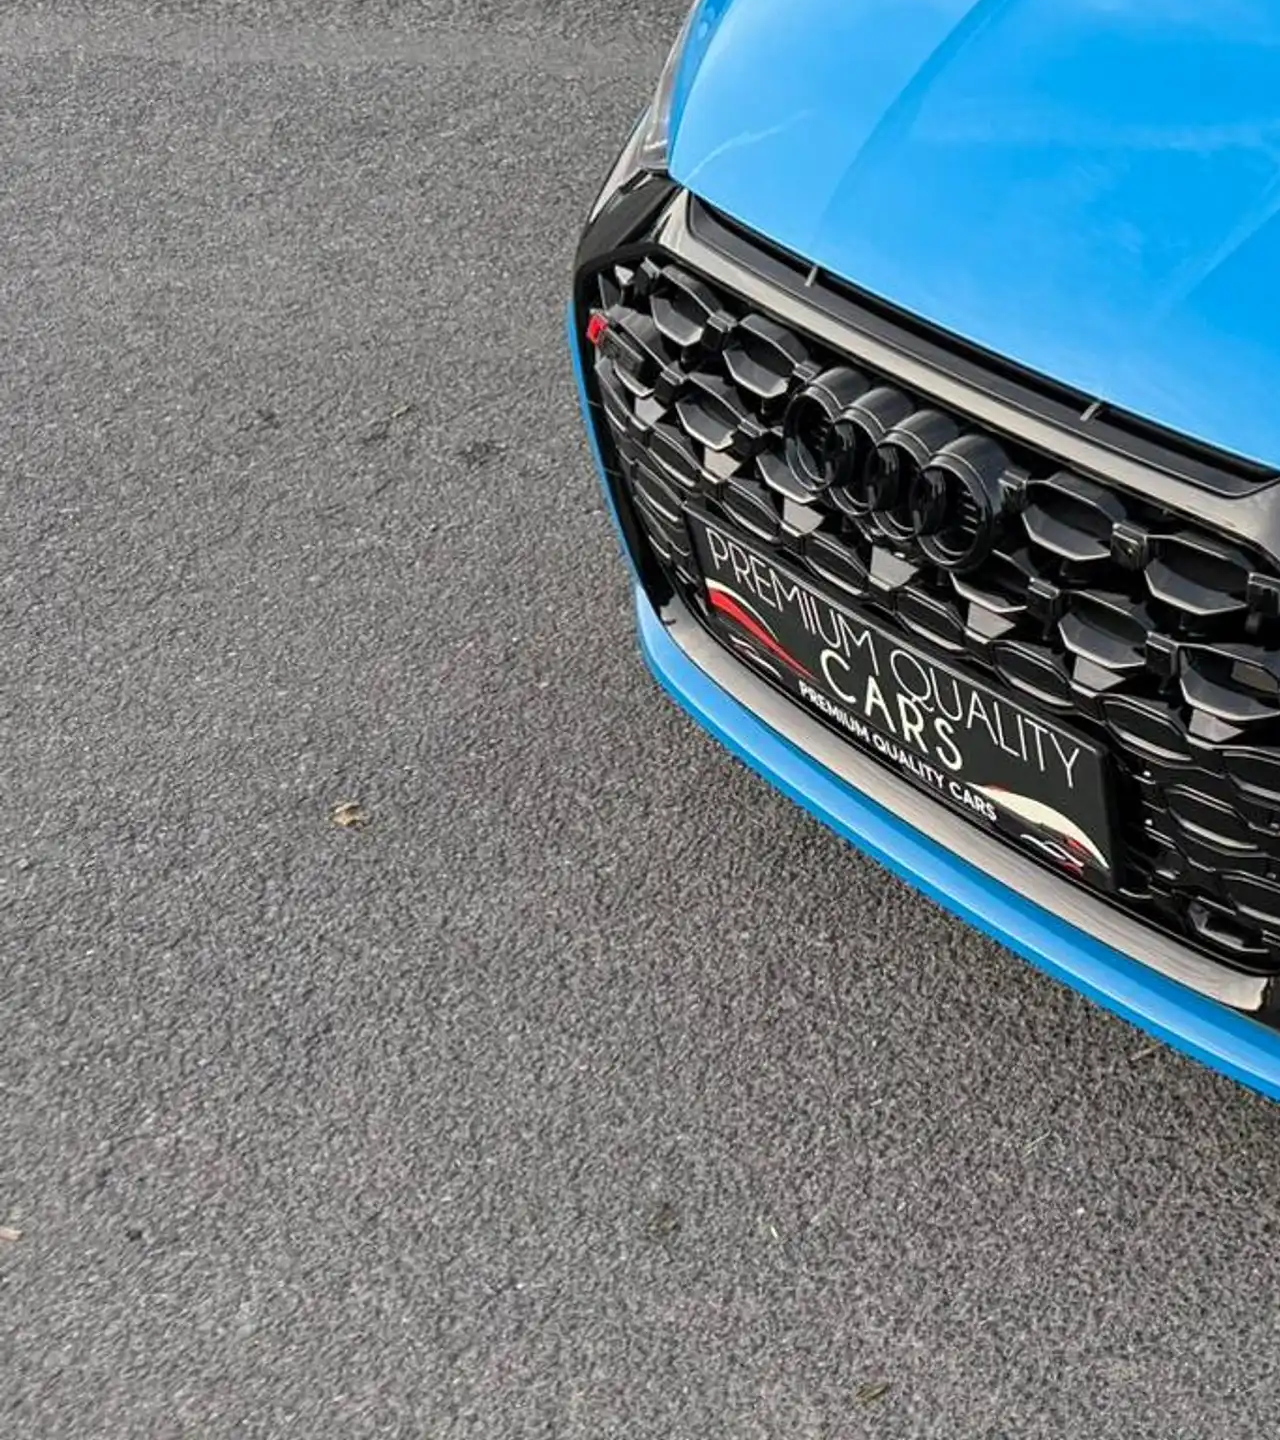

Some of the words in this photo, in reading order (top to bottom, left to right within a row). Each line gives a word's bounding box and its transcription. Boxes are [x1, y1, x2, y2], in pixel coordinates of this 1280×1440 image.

[706, 526, 880, 677] PREMIUM
[888, 648, 1080, 789] QUALITY
[820, 648, 962, 771] CARS
[799, 679, 870, 743] PREMIUM
[871, 733, 944, 791] QUALITY
[949, 781, 997, 822] CARS
